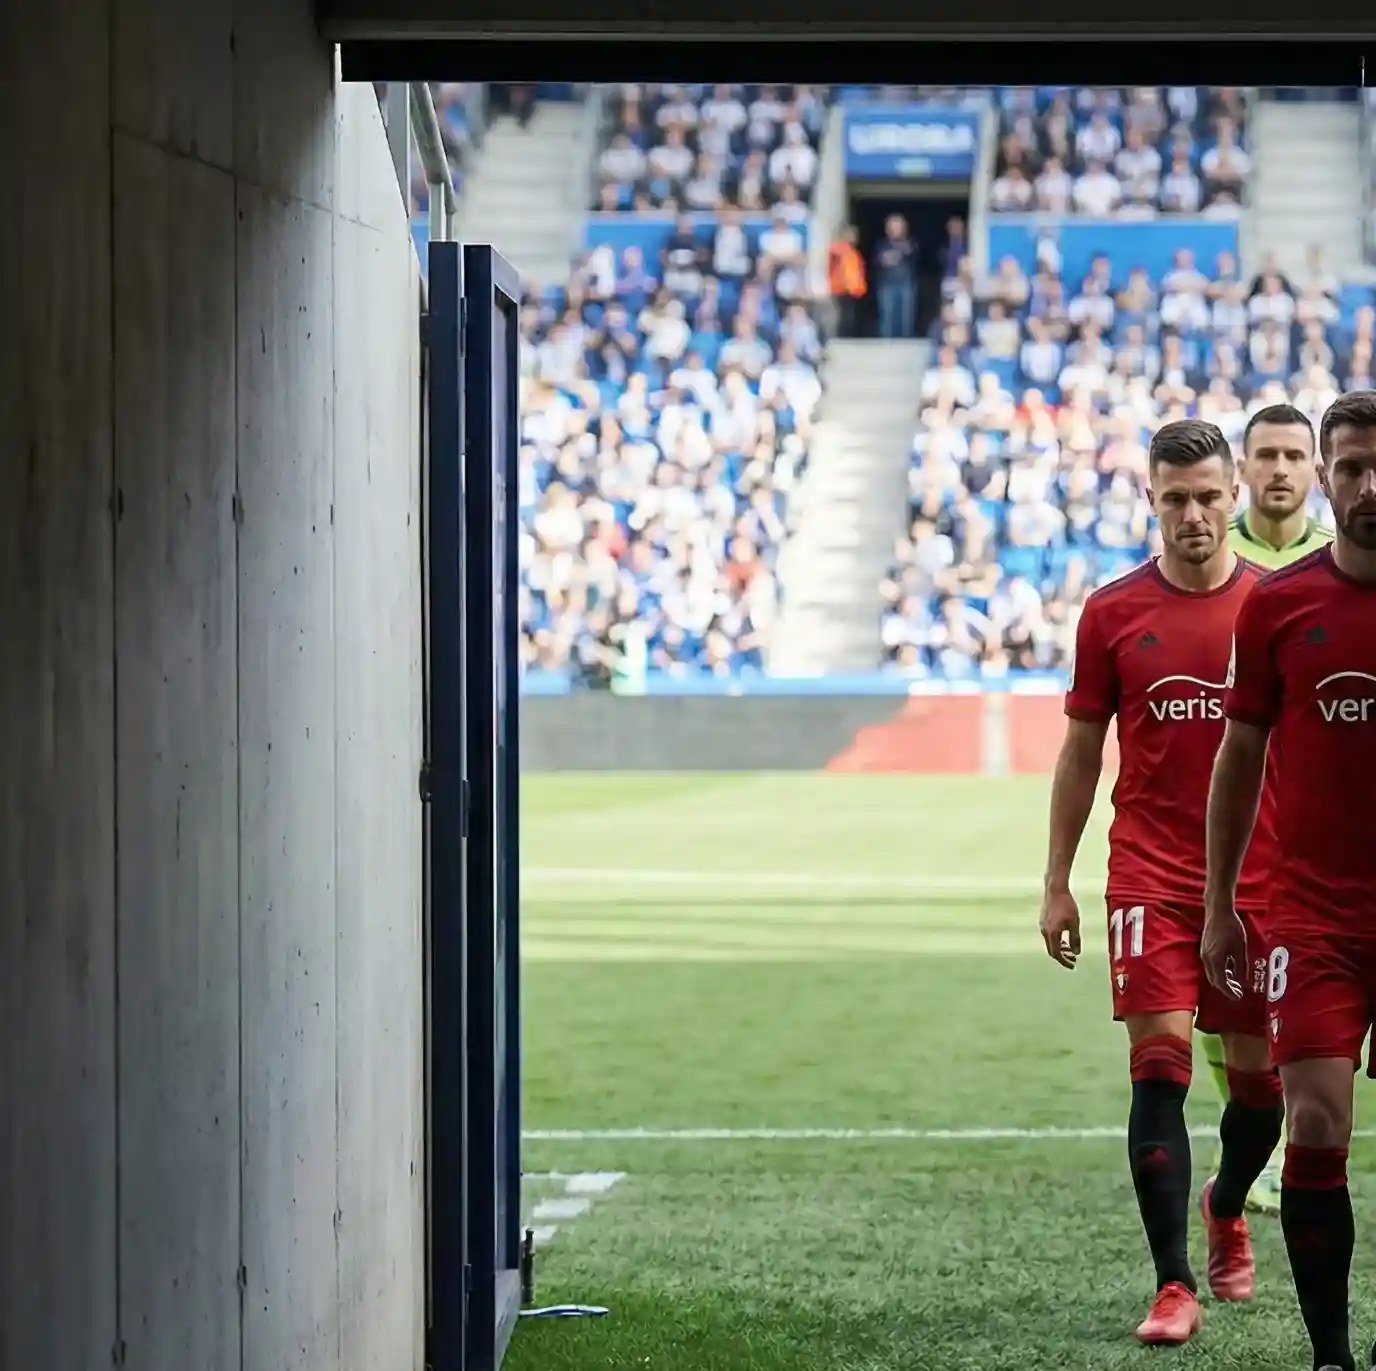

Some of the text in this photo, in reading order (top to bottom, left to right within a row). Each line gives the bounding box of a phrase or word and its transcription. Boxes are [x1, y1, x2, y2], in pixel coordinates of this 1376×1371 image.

[1148, 690, 1224, 721] veris
[1109, 906, 1145, 961] 11
[1268, 946, 1290, 1002] 8
